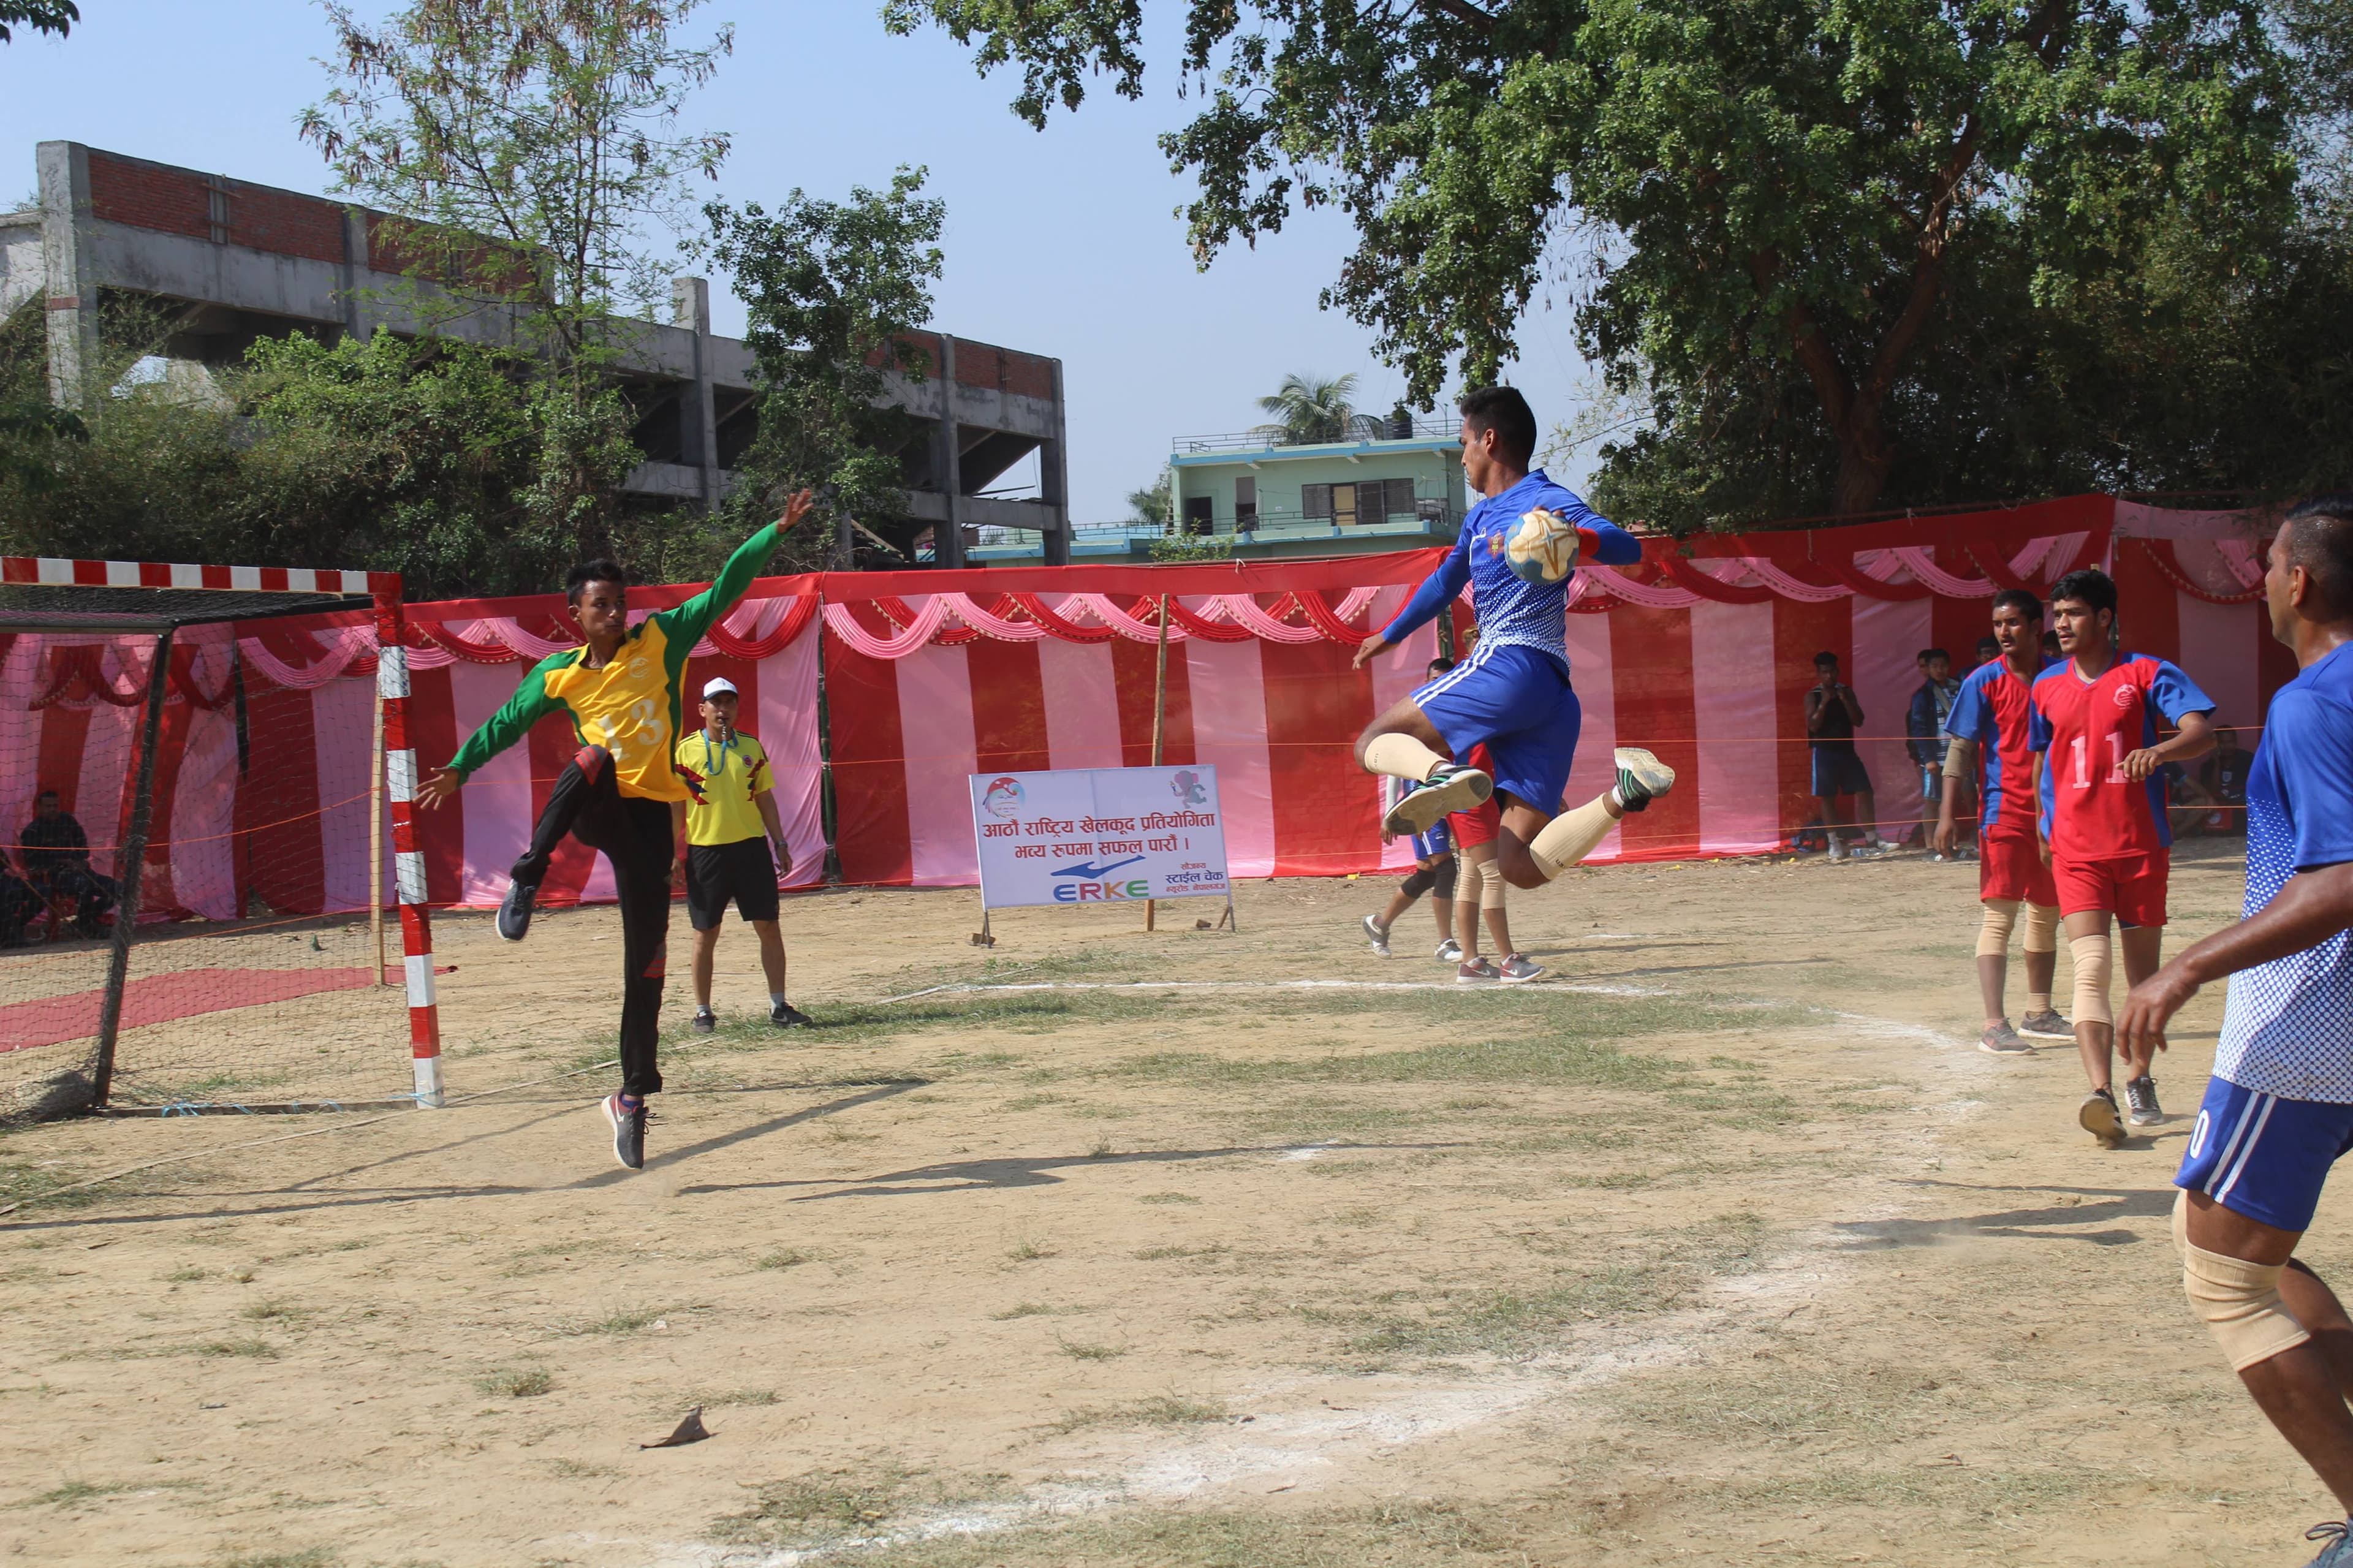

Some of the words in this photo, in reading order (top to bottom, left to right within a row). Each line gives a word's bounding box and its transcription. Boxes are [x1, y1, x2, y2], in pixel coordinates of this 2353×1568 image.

[597, 699, 664, 762] 13
[2071, 731, 2129, 789] 11
[1078, 816, 1135, 835] खेलकूद
[1140, 811, 1215, 831] प्रतियोगिता
[1015, 844, 1047, 858] भव्य
[1099, 840, 1143, 855] सफल
[1165, 871, 1200, 884] स्टाईल
[1204, 869, 1224, 881] चेक
[1053, 880, 1149, 901] ERKE
